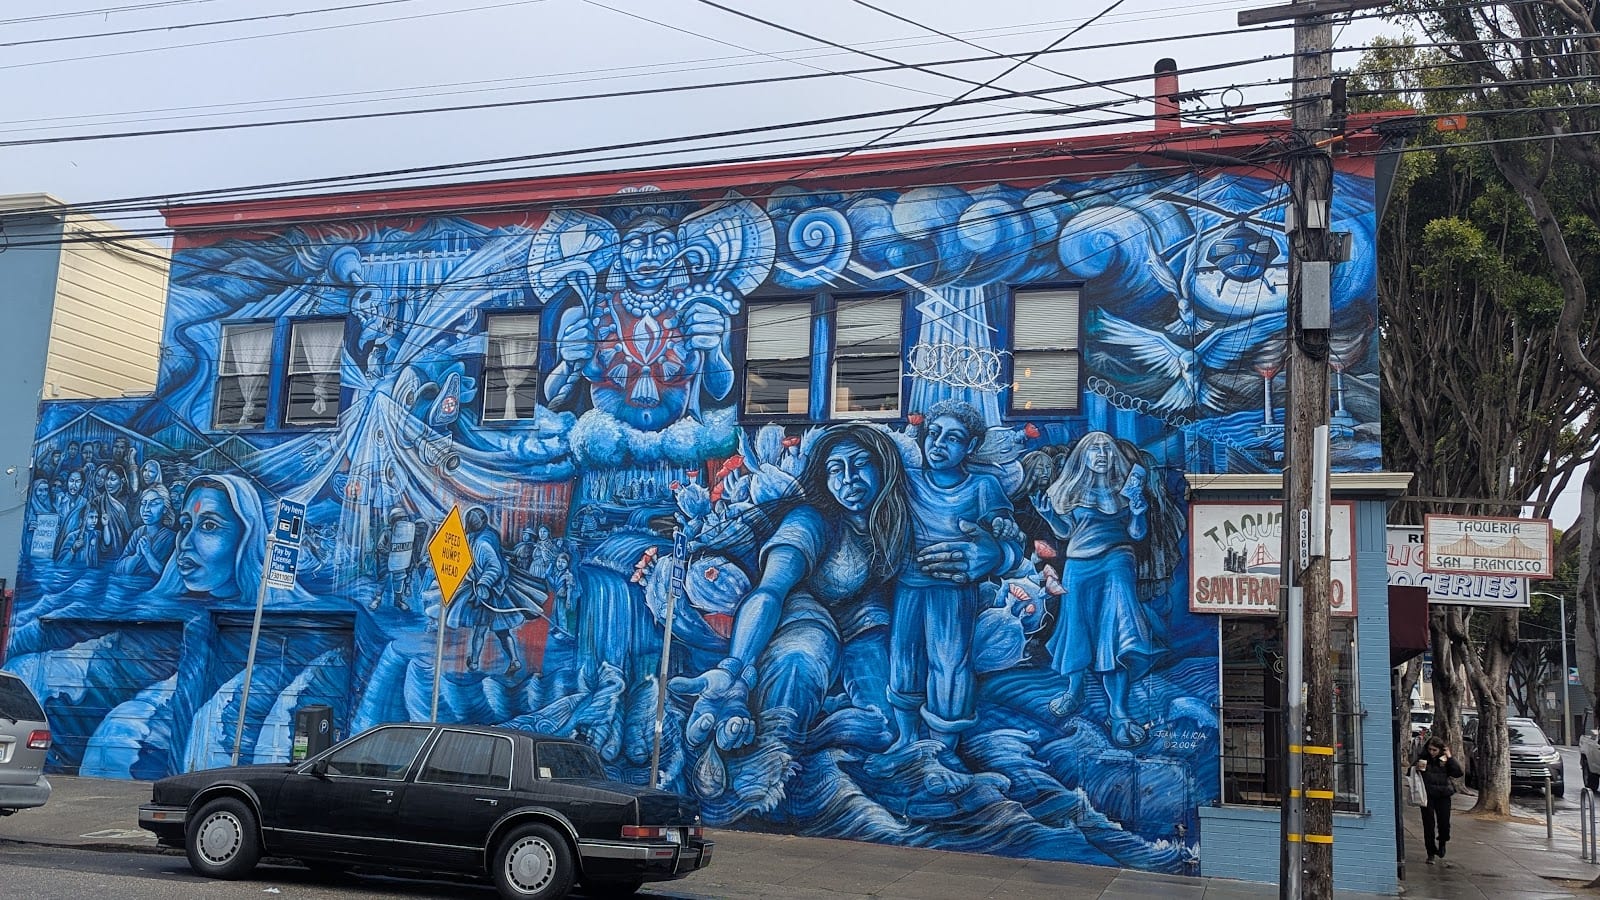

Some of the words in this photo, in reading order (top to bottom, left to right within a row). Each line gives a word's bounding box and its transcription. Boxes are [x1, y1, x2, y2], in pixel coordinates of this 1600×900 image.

[281, 502, 291, 514] Pay
[291, 505, 303, 516] here
[1456, 521, 1521, 534] TAQUERIA
[445, 532, 460, 547] SPEED
[274, 546, 284, 556] Pay
[284, 548, 291, 558] by
[442, 547, 460, 563] HUMPS
[272, 562, 285, 571] Plate
[273, 555, 291, 565] License
[1436, 556, 1461, 568] SAN
[1473, 558, 1542, 573] FRANCISCO
[441, 563, 458, 577] AHEAD
[1195, 575, 1234, 605] SAN
